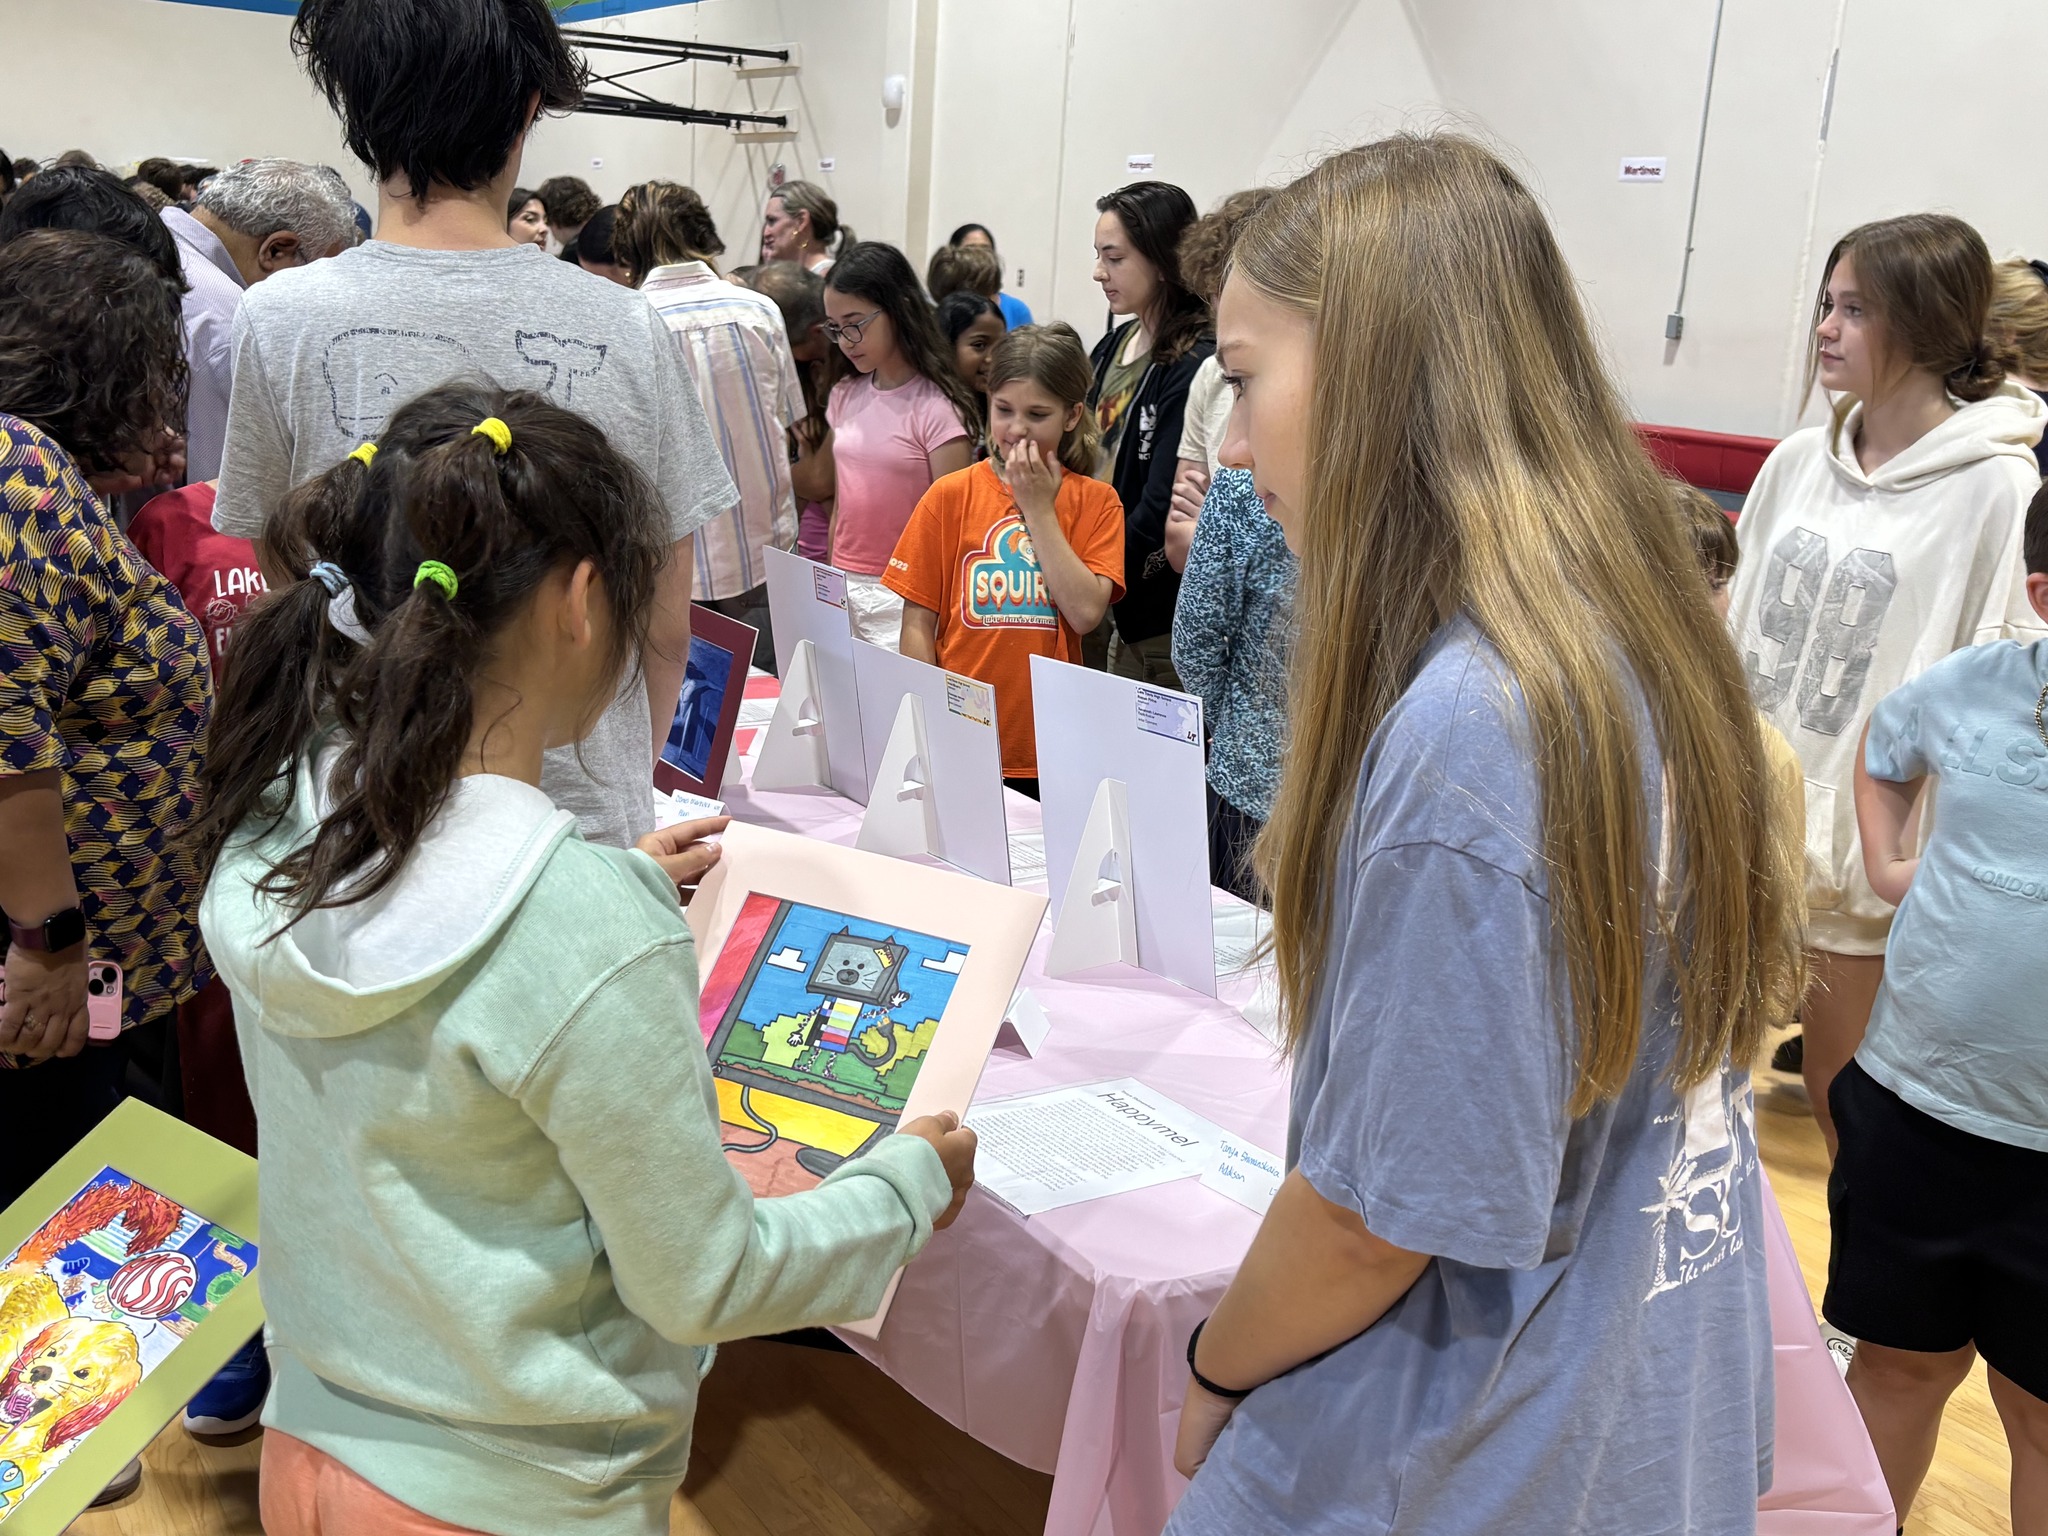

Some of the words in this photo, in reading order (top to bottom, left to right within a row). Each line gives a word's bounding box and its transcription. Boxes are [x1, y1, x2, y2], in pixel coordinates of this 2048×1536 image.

[1624, 165, 1661, 175] Martinez
[889, 557, 909, 571] 022
[976, 569, 1057, 611] SQUIR
[1749, 526, 1898, 736] 98
